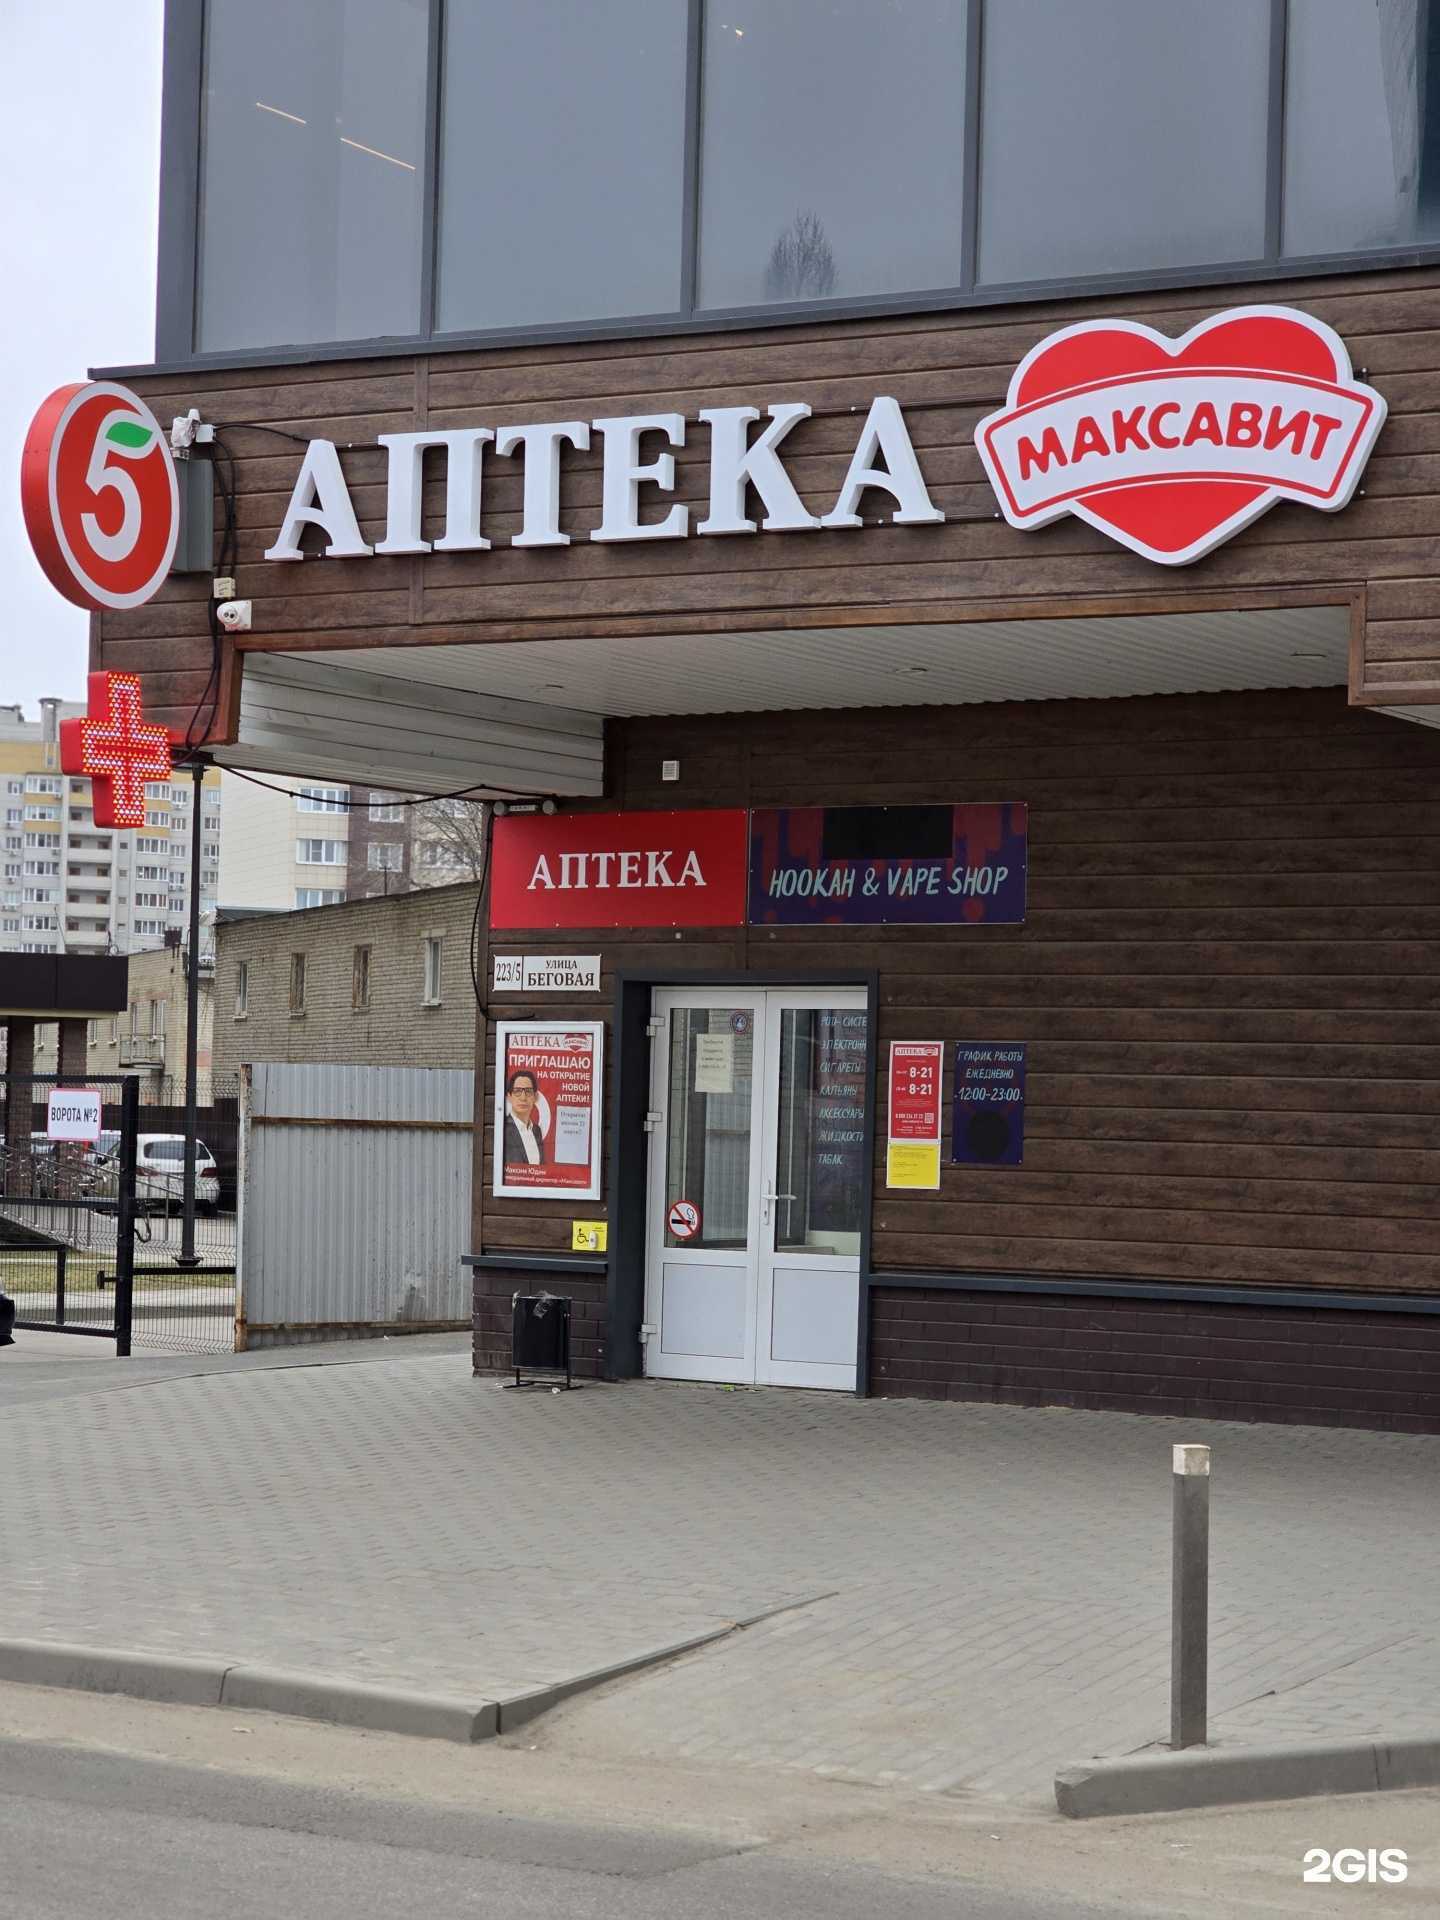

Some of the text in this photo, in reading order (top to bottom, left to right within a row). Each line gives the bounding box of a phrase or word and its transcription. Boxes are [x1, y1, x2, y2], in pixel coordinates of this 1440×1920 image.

[1016, 401, 1342, 480] МАКСАВИТ
[80, 409, 157, 562] 5
[264, 396, 945, 561] АПТЕКА
[527, 850, 707, 890] АПТЕКА
[769, 866, 1009, 898] HOOKAH & VAPE SHOP
[496, 961, 521, 983] 223/5
[545, 960, 578, 970] УЛИЦА
[527, 972, 595, 987] БЕГОВАЯ
[511, 1034, 560, 1048] АПТЕКА
[509, 1054, 591, 1069] ПРИГЛАШАЮ
[958, 1050, 1023, 1061] ГРАФИК РАБОТЫ
[537, 1071, 591, 1081] НА ОТКРЫТИЕ
[909, 1066, 933, 1078] 8-21
[966, 1068, 1014, 1079] ЕЖЕДНЕВНО
[562, 1082, 590, 1092] НОВОЙ
[908, 1083, 932, 1095] 8-21
[557, 1094, 590, 1103] АПТЕКИ!
[51, 1106, 81, 1121] ВОРОТА
[818, 1153, 843, 1165] ТАБАК
